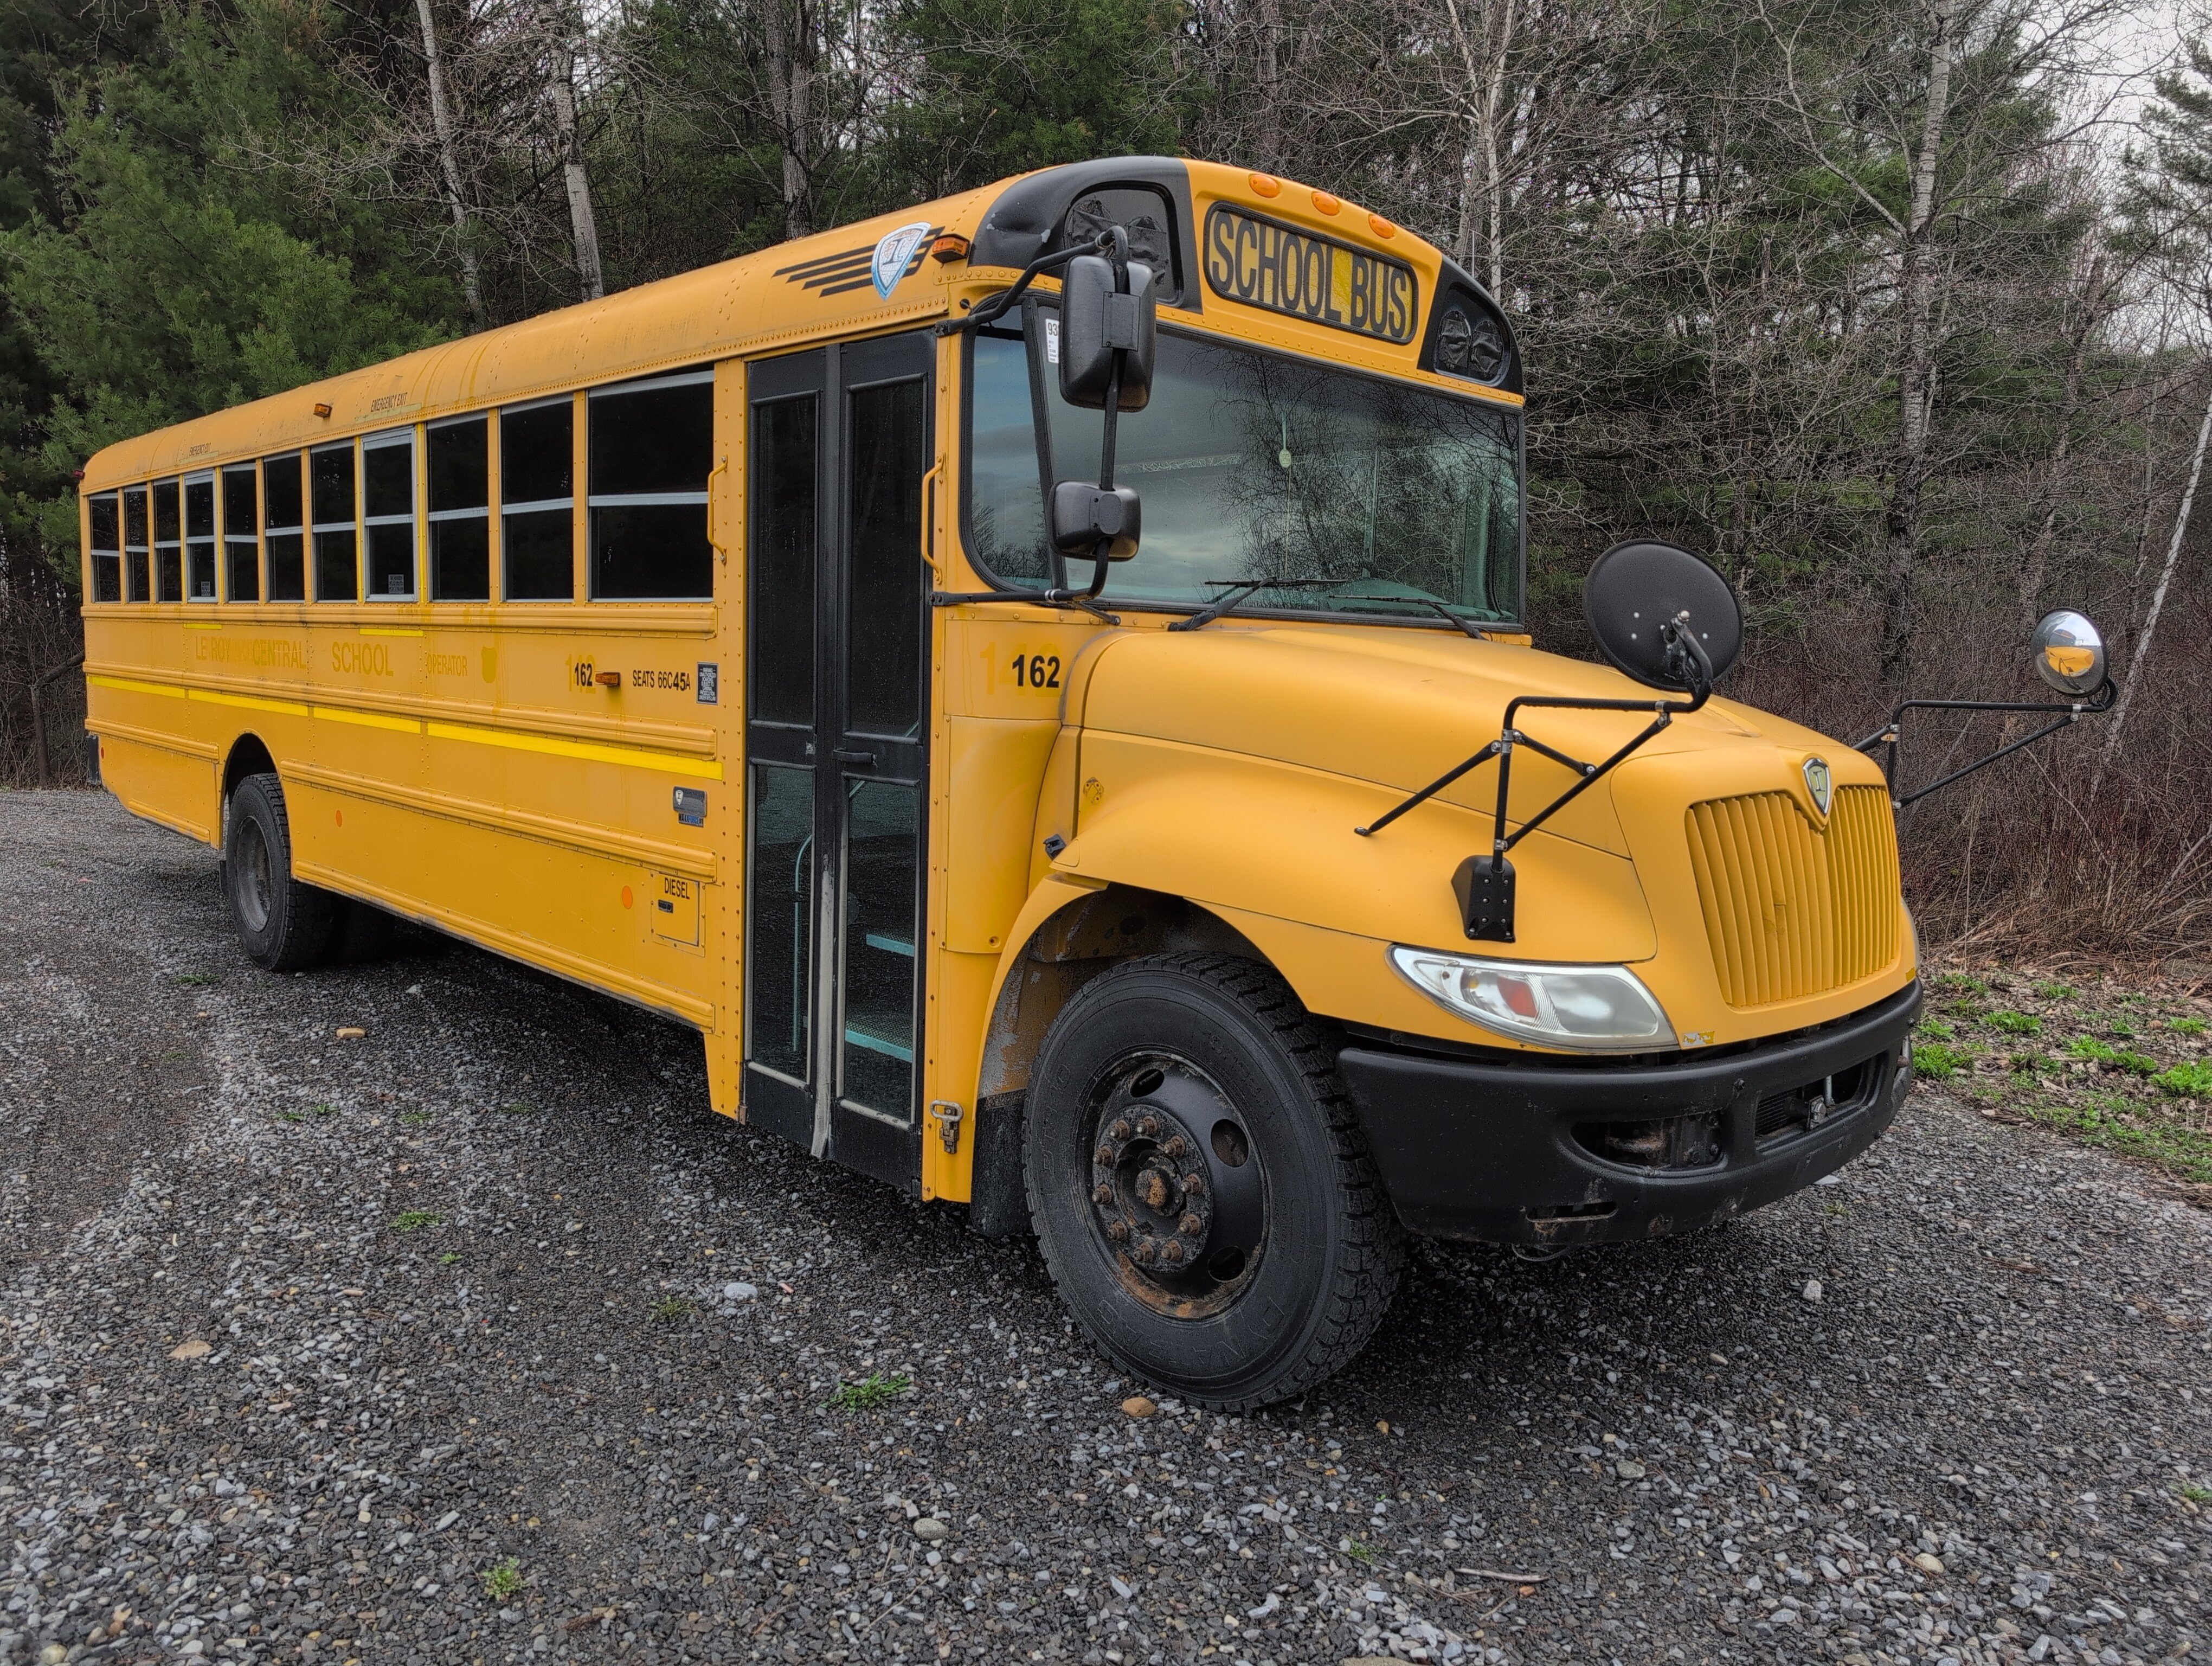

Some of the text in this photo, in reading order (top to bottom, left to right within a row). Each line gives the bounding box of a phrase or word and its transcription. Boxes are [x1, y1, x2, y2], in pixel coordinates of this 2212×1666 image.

[1212, 212, 1406, 338] SCHOOL BUS
[1048, 322, 1058, 336] 93
[371, 392, 408, 412] EMERGENCY EXIT
[189, 444, 205, 457] EMERGENCY
[252, 638, 307, 669] CENTRAL
[332, 642, 394, 677] SCHOOL
[427, 653, 468, 677] OPERATOR
[575, 662, 593, 687] 162
[632, 670, 655, 688] SEATS
[658, 671, 691, 691] 66C45A
[1012, 654, 1060, 688] 162
[664, 877, 690, 900] DIESEL
